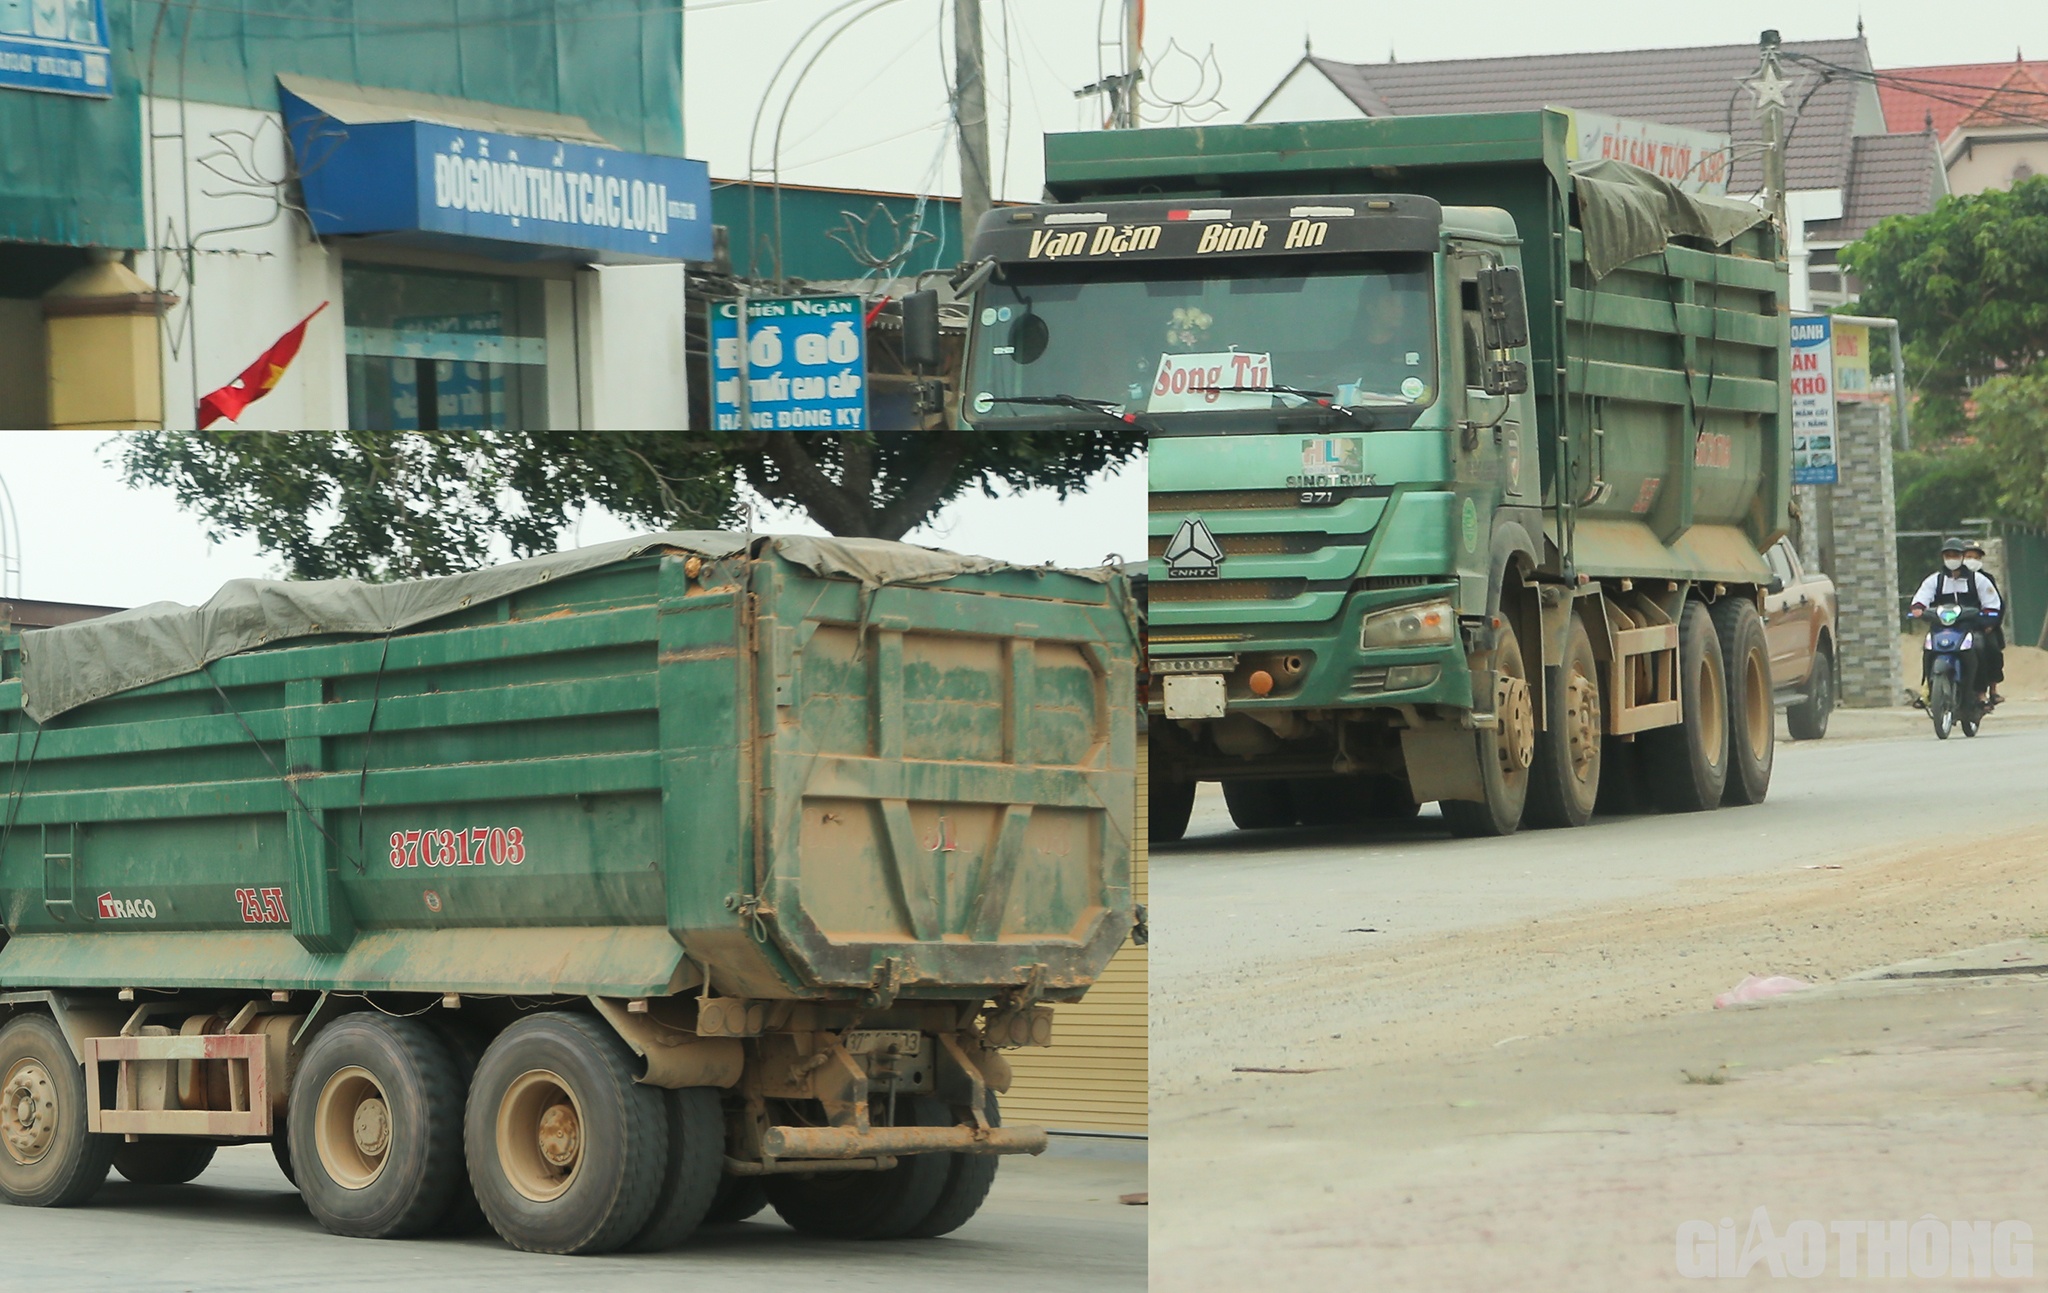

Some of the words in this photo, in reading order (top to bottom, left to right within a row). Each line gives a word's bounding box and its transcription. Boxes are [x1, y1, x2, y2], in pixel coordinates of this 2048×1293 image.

[493, 150, 528, 227] NỘI
[527, 145, 579, 225] THẤT
[578, 157, 621, 229] CÁC
[620, 178, 668, 243] LOẠI
[1196, 220, 1268, 254] Bình
[1284, 219, 1328, 249] An
[1154, 360, 1222, 403] Song
[1286, 474, 1376, 488] SINOTRUK
[1300, 492, 1332, 503] 371
[1170, 569, 1215, 577] CNHTC
[389, 826, 526, 868] 37C31703
[99, 896, 157, 919] TRAGO
[235, 887, 290, 923] 25.5T
